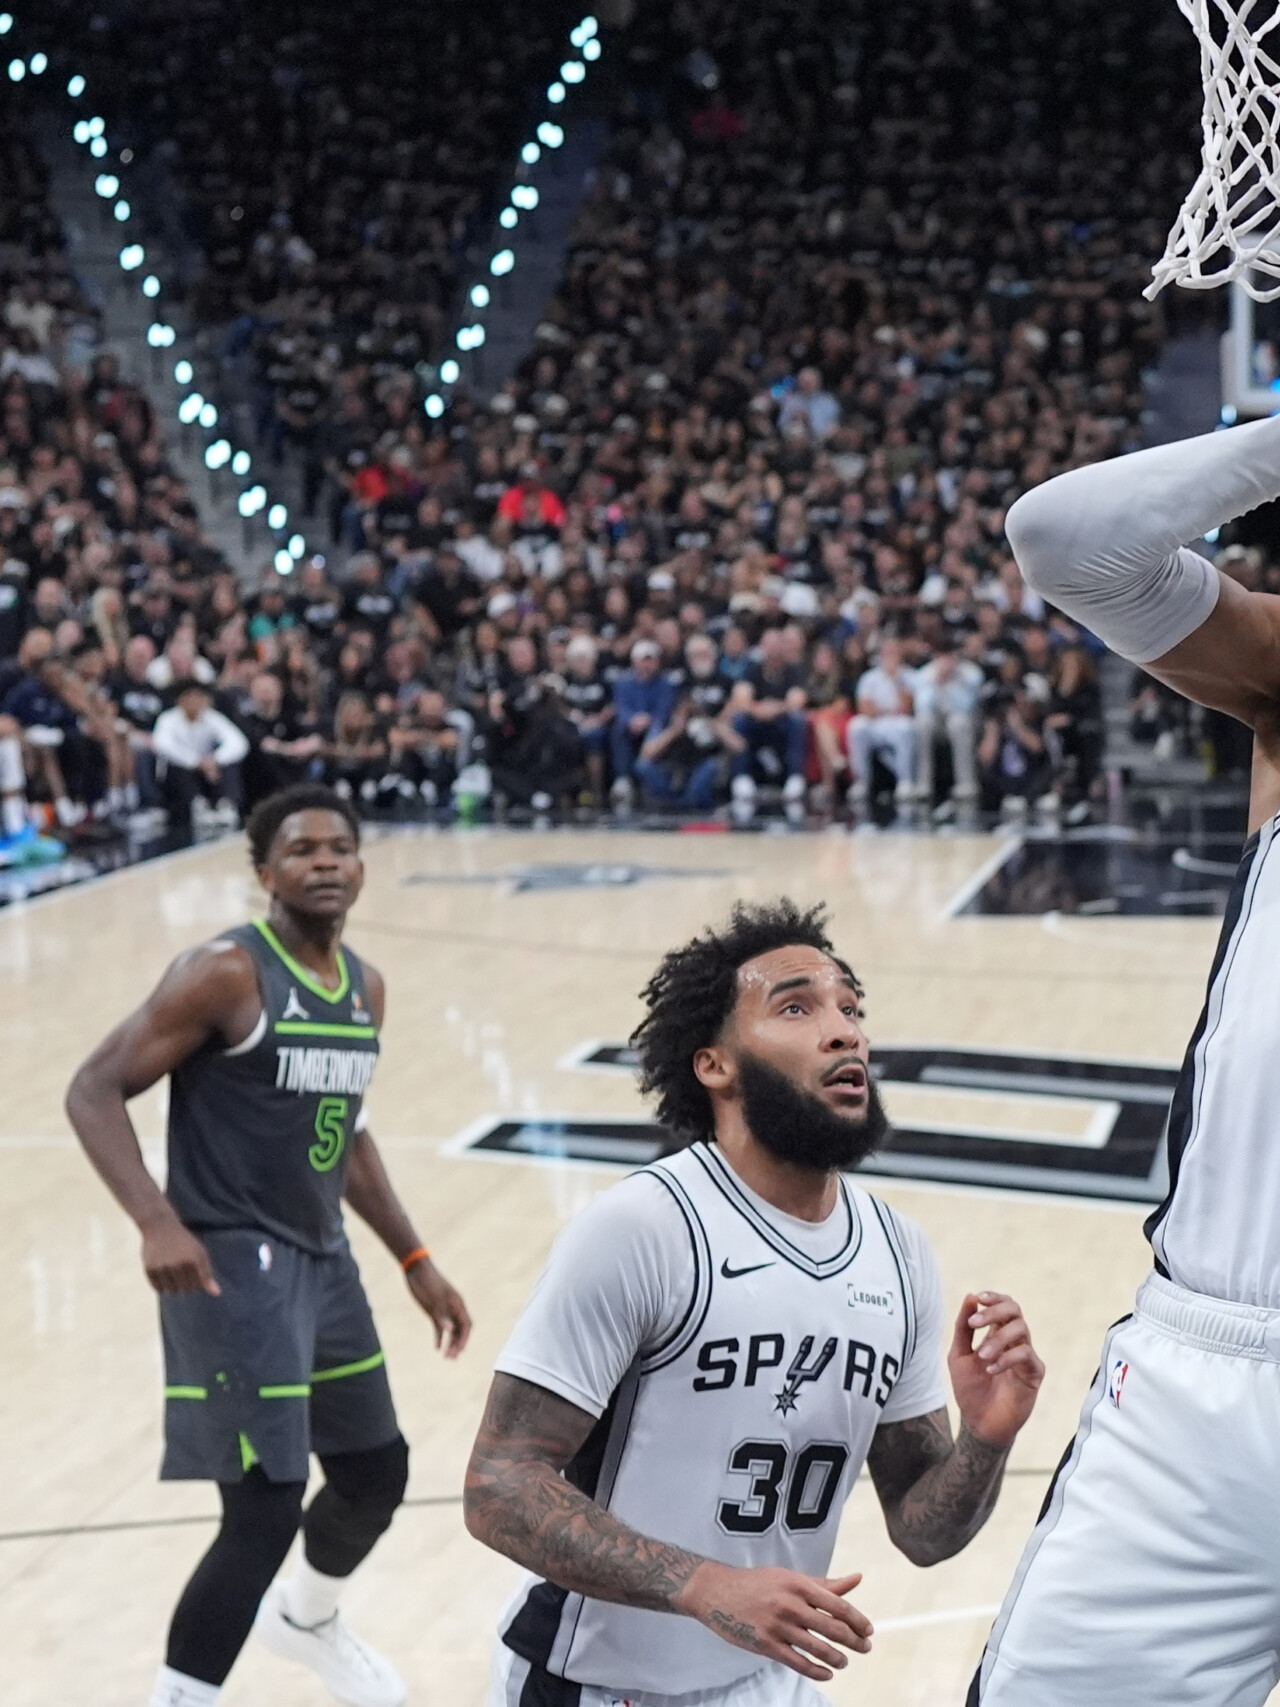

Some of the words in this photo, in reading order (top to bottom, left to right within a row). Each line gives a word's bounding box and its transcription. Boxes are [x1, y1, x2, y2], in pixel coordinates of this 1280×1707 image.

[308, 1097, 348, 1172] 5
[853, 1290, 888, 1308] LEDGER
[692, 1333, 900, 1417] SPURS
[715, 1437, 851, 1537] 30
